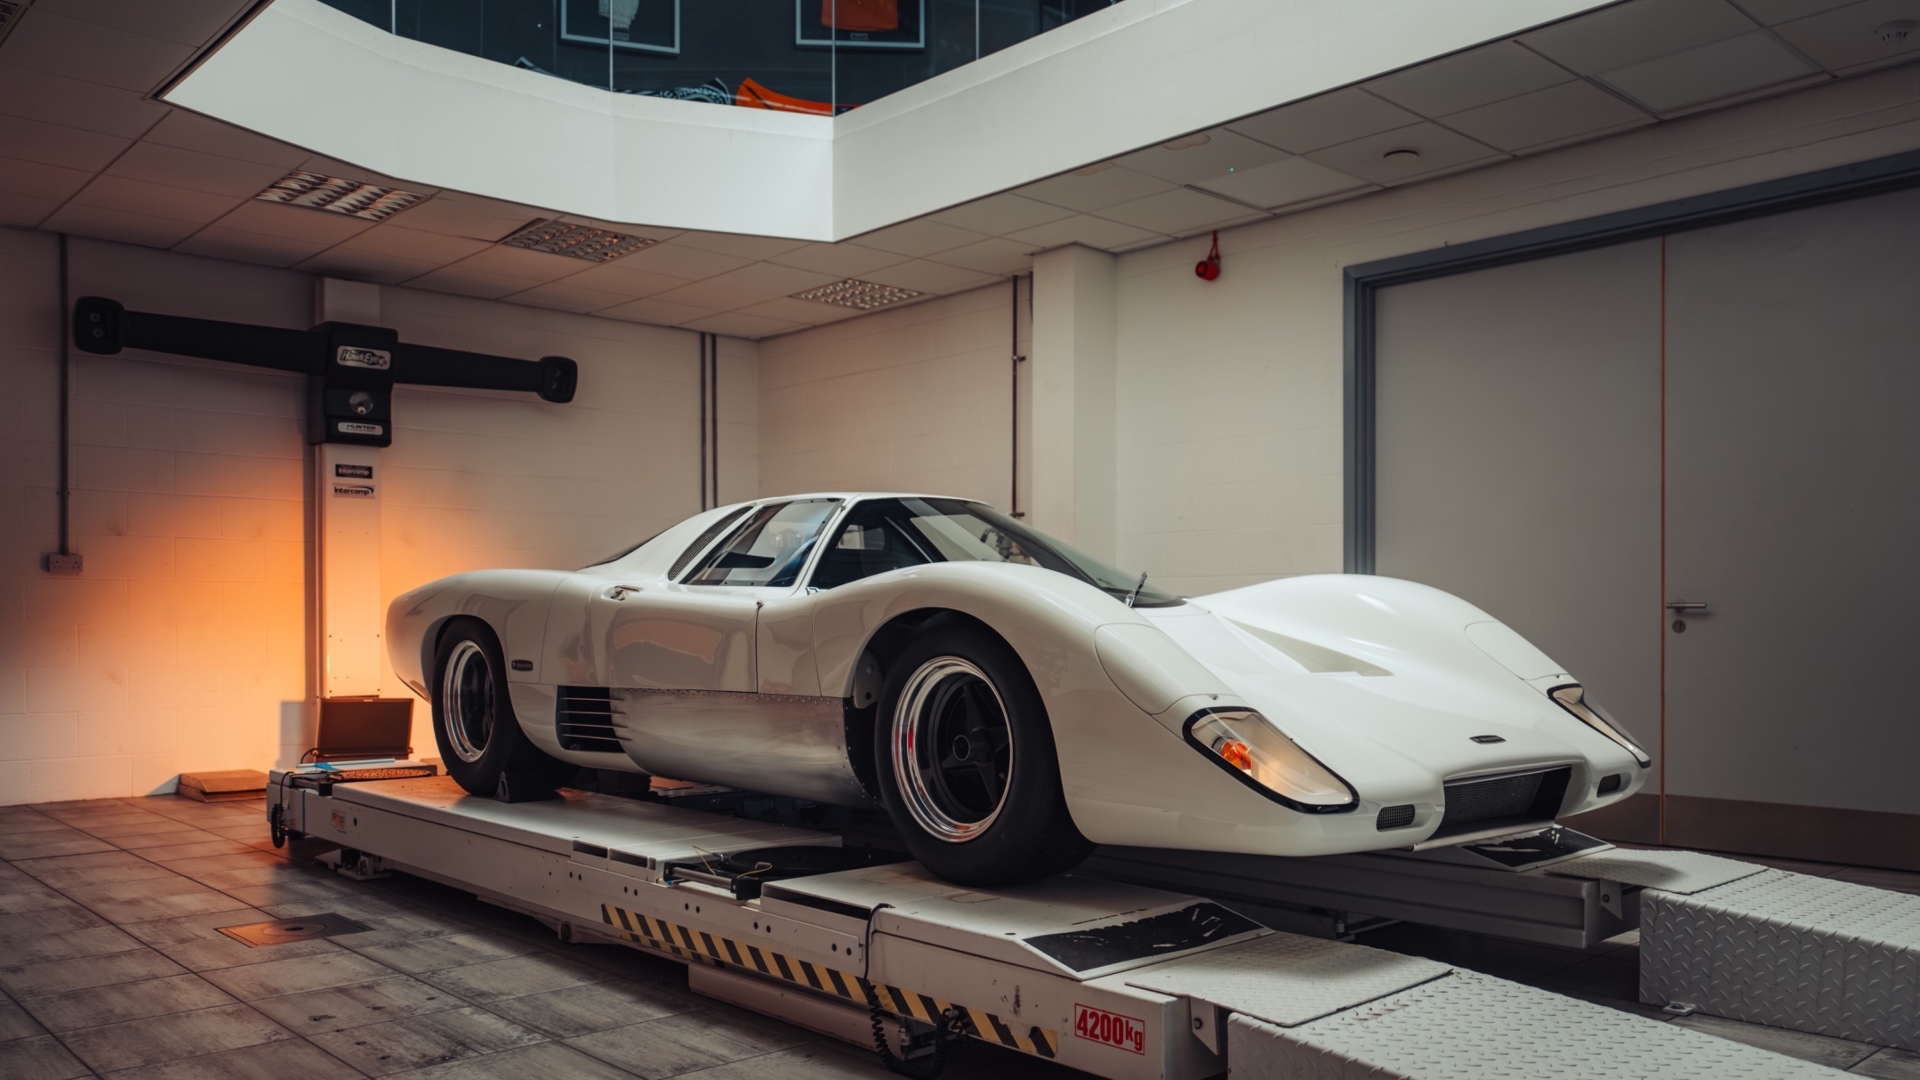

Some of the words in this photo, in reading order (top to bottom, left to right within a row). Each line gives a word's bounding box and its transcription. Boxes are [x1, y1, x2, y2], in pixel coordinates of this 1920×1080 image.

[341, 350, 379, 364] HawkEye
[338, 467, 370, 476] Intercomp
[334, 486, 370, 496] Intercomp
[1077, 1009, 1143, 1051] 4200kg
